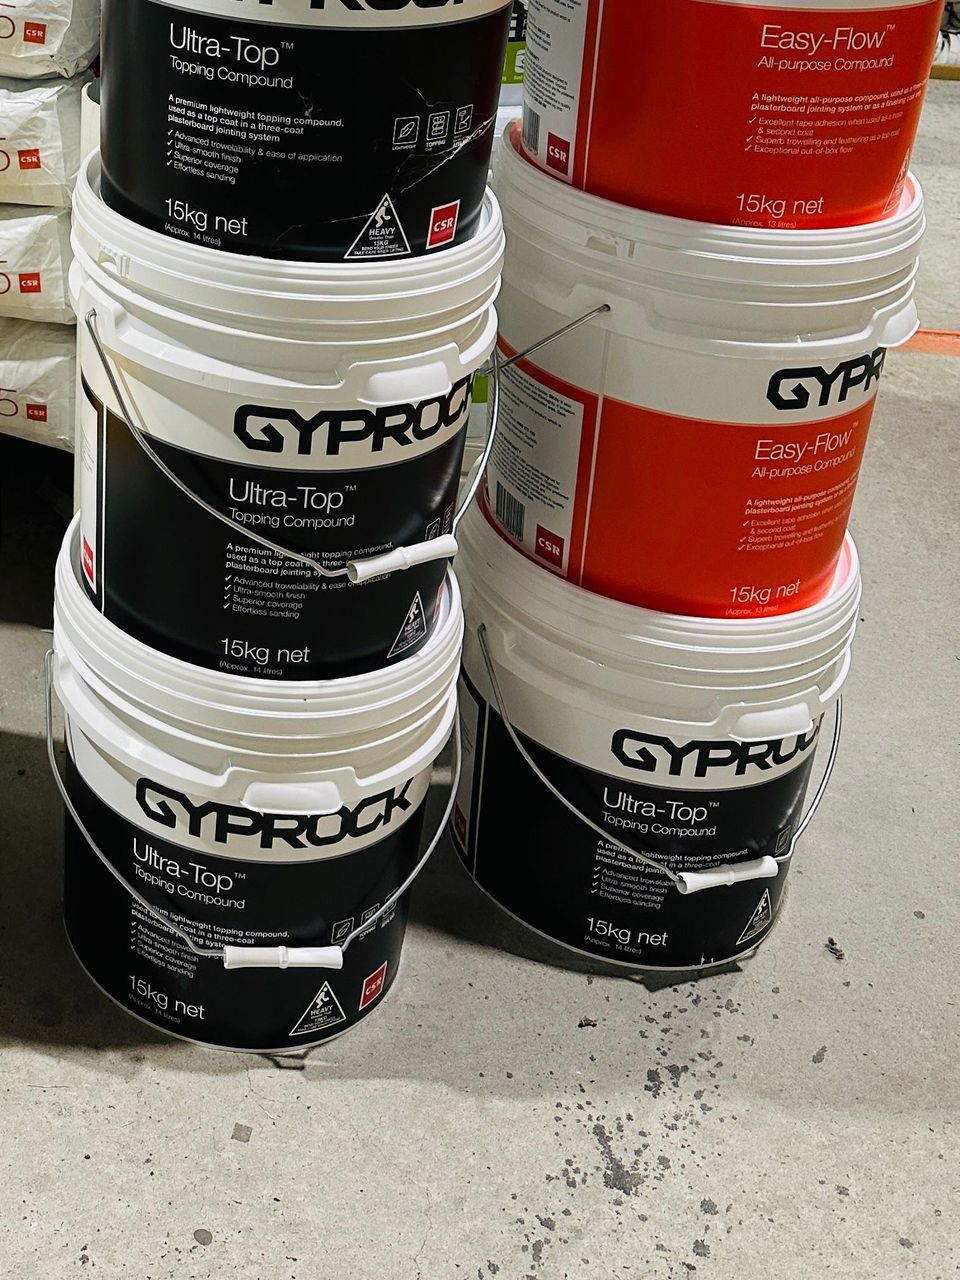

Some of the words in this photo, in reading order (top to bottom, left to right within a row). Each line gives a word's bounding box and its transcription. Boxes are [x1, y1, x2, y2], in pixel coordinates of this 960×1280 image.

[169, 55, 215, 81] Topping
[217, 67, 293, 89] Compound
[758, 56, 831, 73] All-purpose
[834, 55, 894, 72] Compound
[751, 103, 805, 113] plasterboard
[807, 104, 836, 114] jointing
[761, 93, 808, 104] lightweight
[810, 95, 853, 104] all-purpose
[175, 97, 208, 111] premium
[257, 112, 291, 125] topping
[215, 125, 247, 140] jointing
[248, 131, 280, 143] system
[258, 122, 304, 135] three-coat
[548, 145, 567, 162] CSR
[165, 198, 208, 231] 15kg
[215, 214, 249, 236] net
[737, 194, 786, 218] 15kg
[792, 196, 825, 214] net
[434, 217, 454, 233] CSR
[752, 461, 812, 480] All-purpose
[229, 507, 280, 528] Topping
[283, 514, 355, 530] Compound
[538, 537, 560, 557] CSR
[730, 586, 772, 604] 15kg
[775, 579, 801, 597] net
[221, 638, 270, 665] 15kg
[277, 646, 310, 664] net
[601, 811, 648, 833] Topping
[651, 823, 716, 837] Compound
[133, 862, 174, 894] Topping
[177, 884, 245, 910] Compound
[587, 918, 631, 945] 15kg
[638, 931, 669, 947] net
[129, 975, 169, 1010] 15kg
[175, 998, 205, 1020] net
[365, 979, 383, 997] CSR
